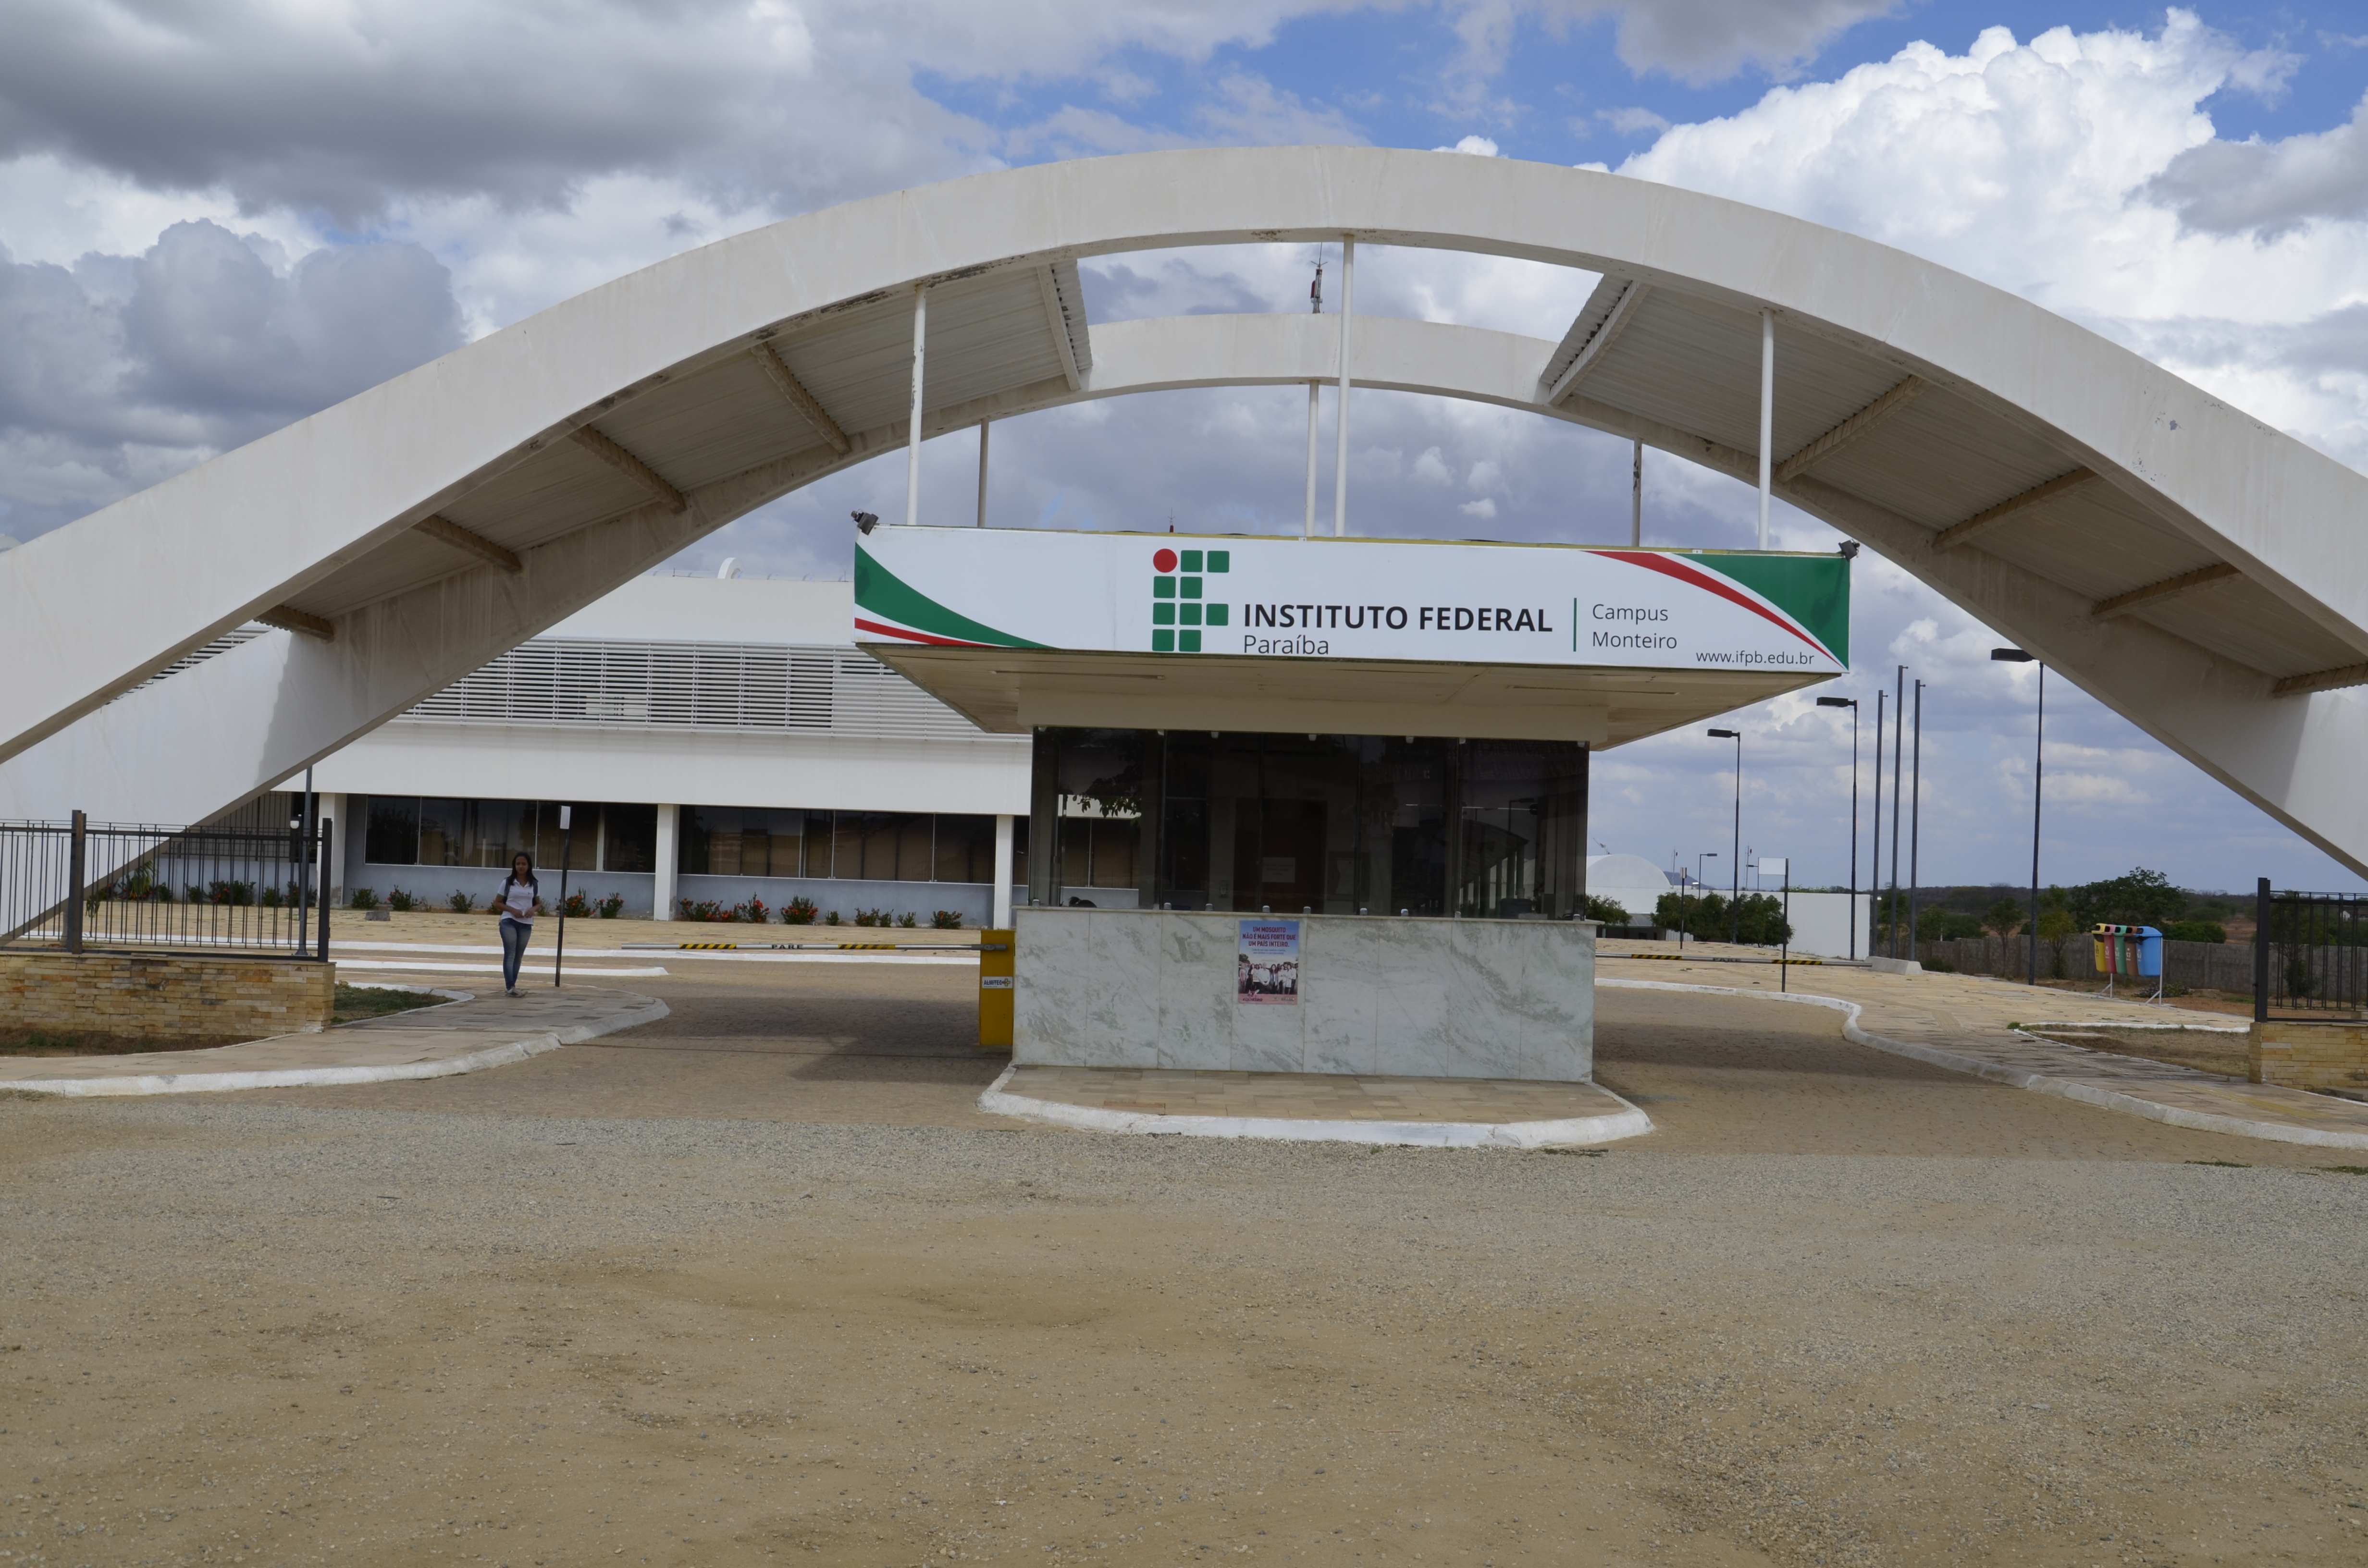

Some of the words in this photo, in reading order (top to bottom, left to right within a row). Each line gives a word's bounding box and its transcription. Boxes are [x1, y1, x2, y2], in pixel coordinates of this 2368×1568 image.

[1245, 604, 1408, 630] INSTITUTO
[1419, 607, 1553, 632] FEDERAL
[1592, 604, 1668, 625] Campus
[1244, 635, 1329, 655] Paraíba
[1593, 631, 1677, 649] Monteiro
[1696, 650, 1815, 667] www.ifpb.edu.br
